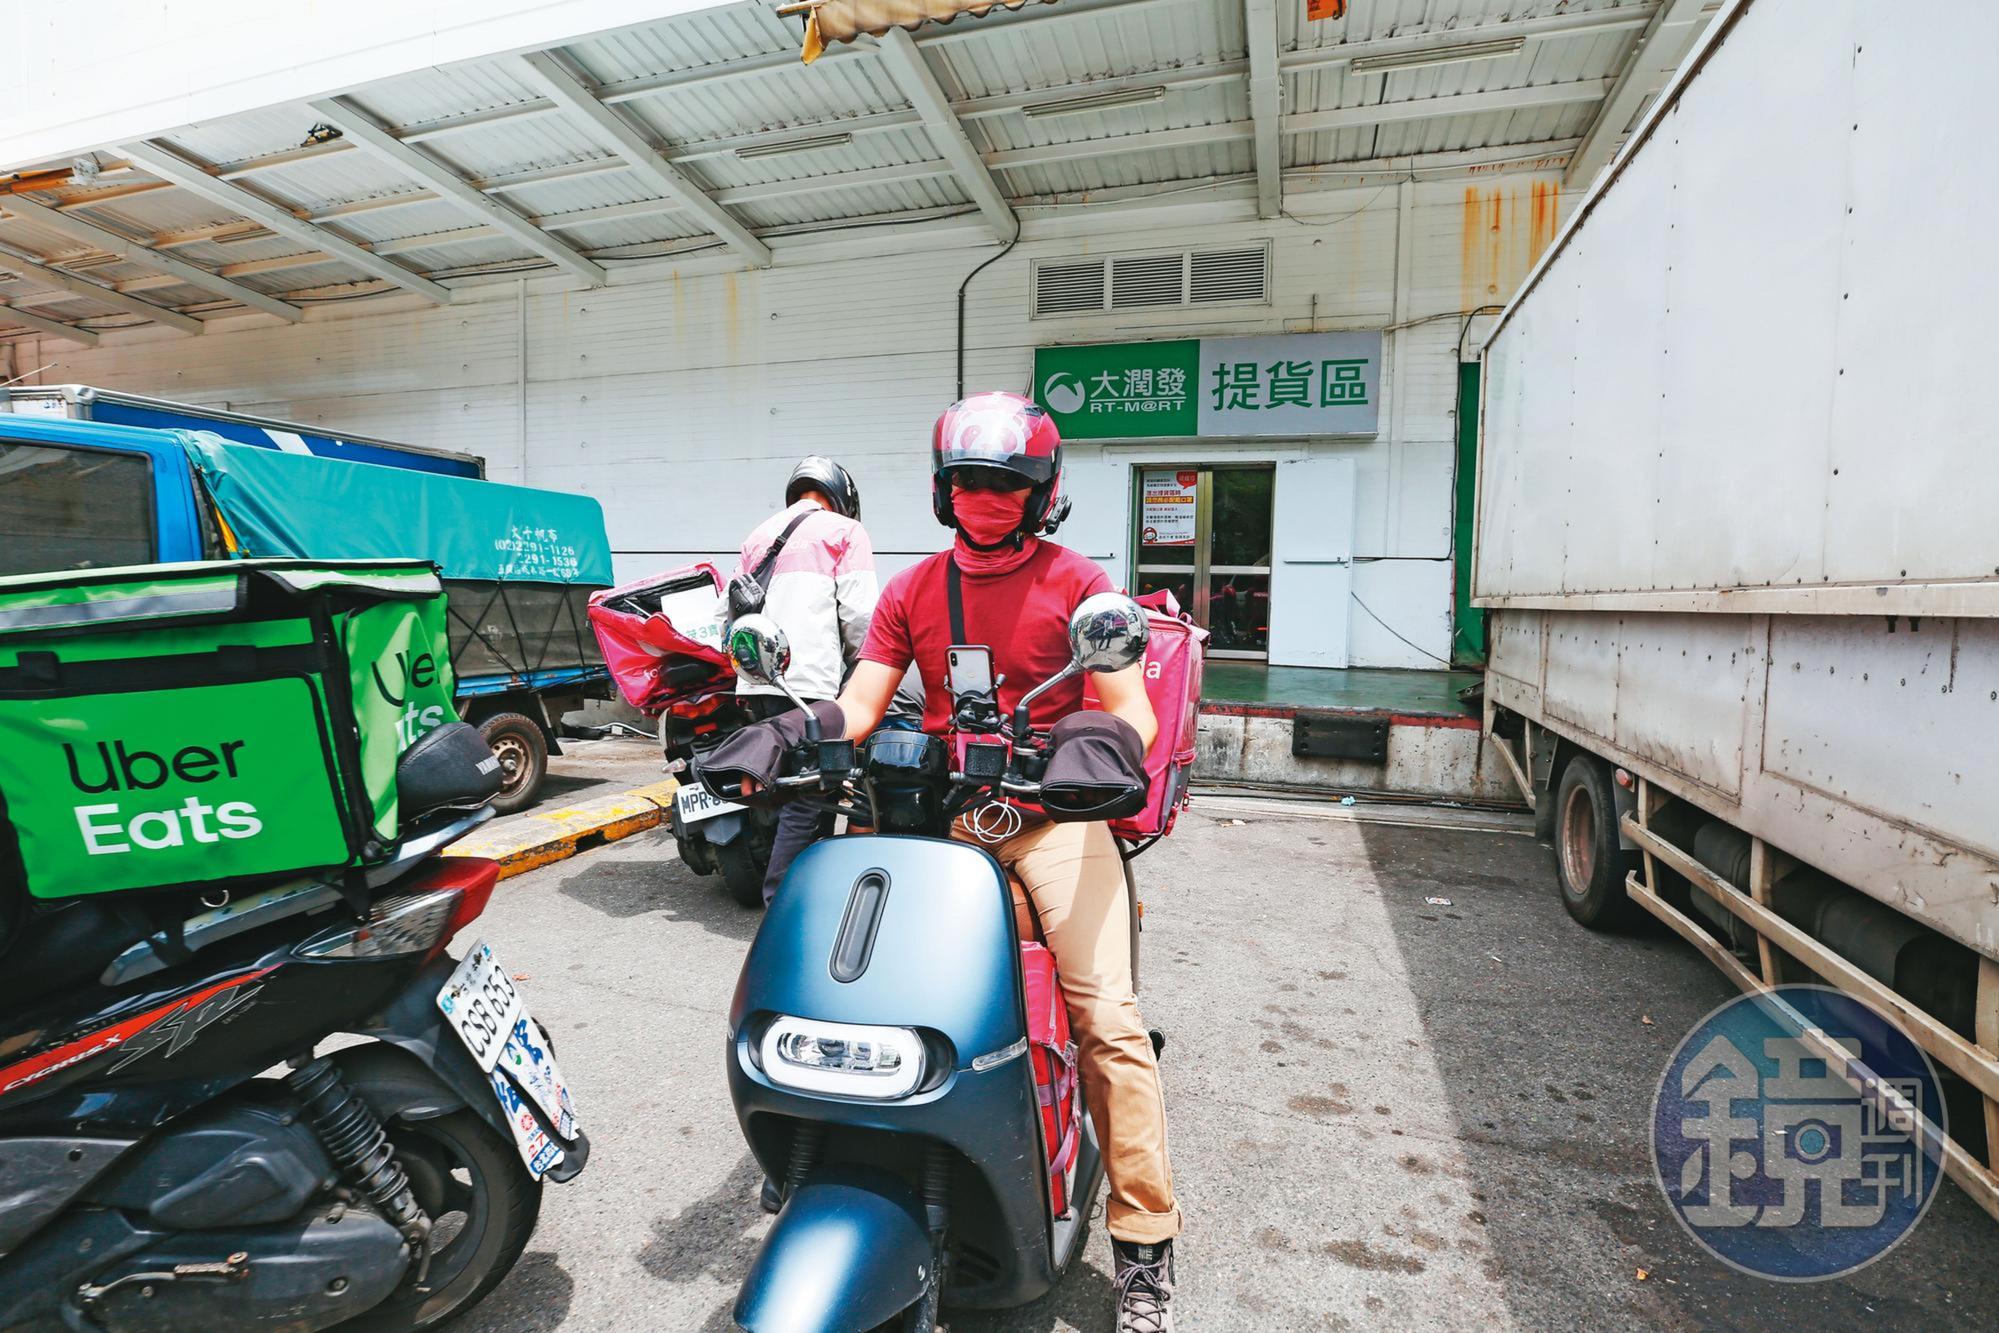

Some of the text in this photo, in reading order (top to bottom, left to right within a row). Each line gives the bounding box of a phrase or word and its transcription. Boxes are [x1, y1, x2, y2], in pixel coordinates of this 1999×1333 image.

[1089, 399, 1185, 414] RT-M@RT
[1090, 367, 1187, 398] 大潤發
[1211, 358, 1370, 412] 提貨區
[61, 739, 245, 794] Uber
[74, 796, 263, 856] Eats
